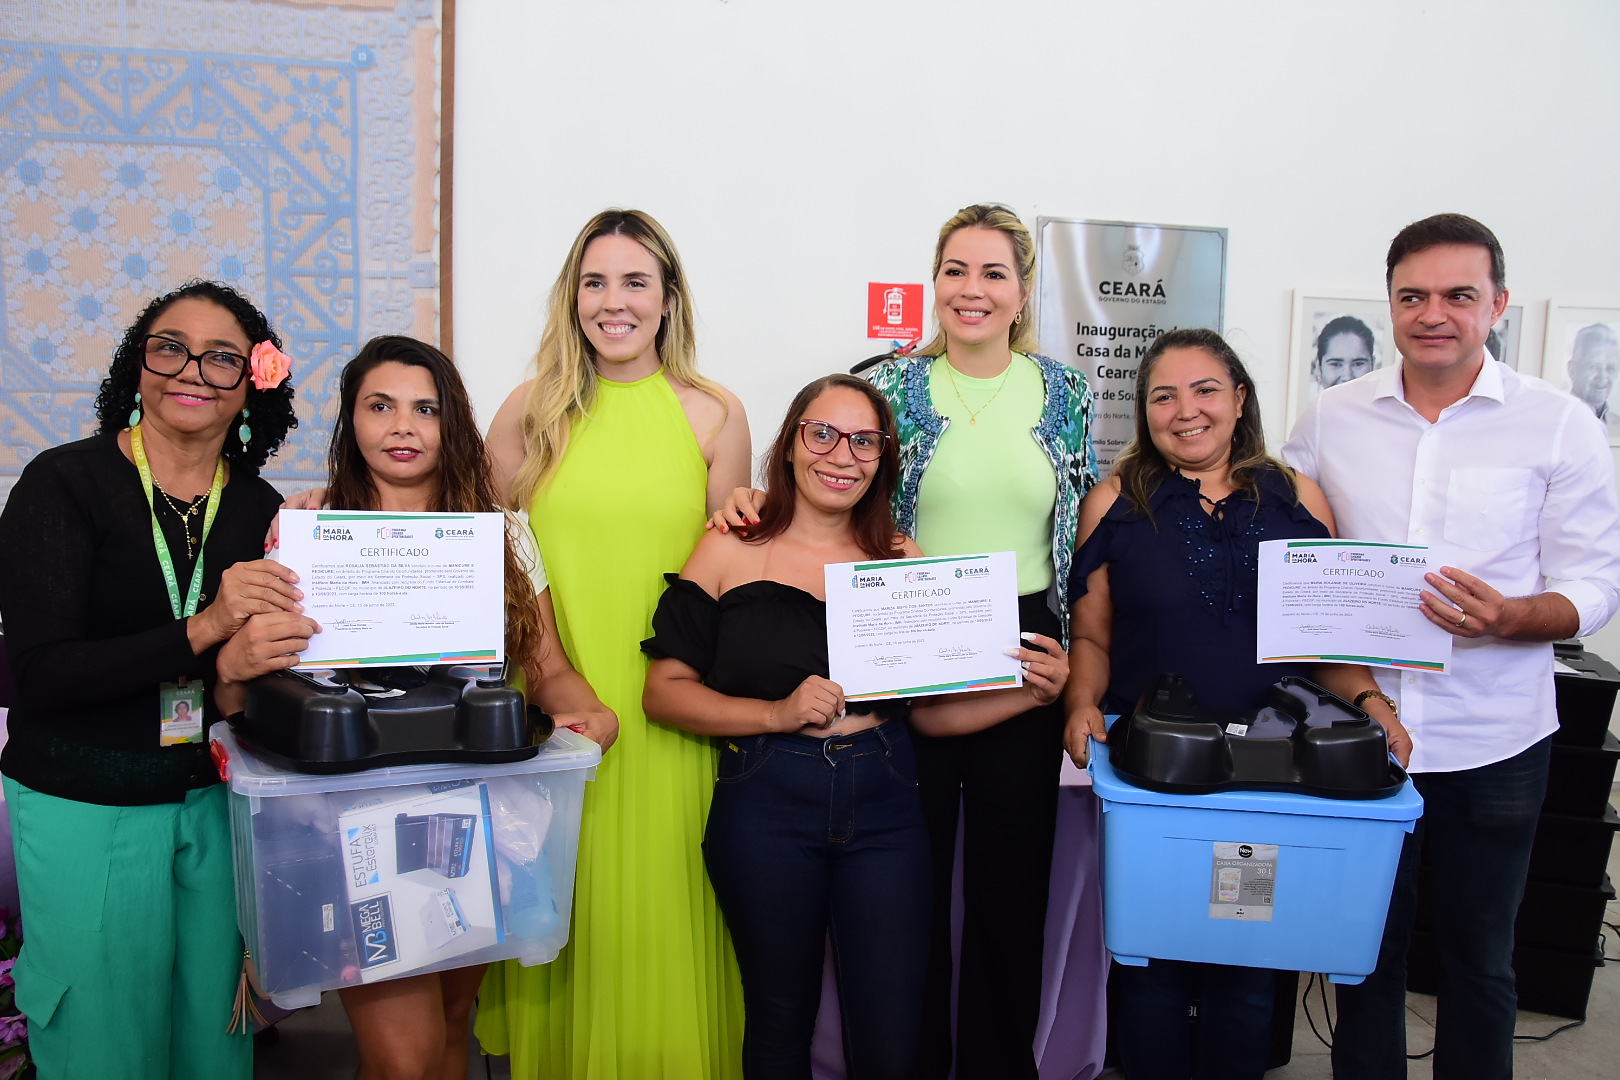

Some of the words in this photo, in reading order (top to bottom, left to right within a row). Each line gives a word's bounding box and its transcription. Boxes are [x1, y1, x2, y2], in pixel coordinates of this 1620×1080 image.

[1098, 279, 1166, 298] CEARÁ
[1098, 296, 1130, 304] GOVERNO
[1076, 322, 1165, 343] Inauguração
[1077, 343, 1110, 357] Casa
[1114, 344, 1131, 358] da
[1102, 389, 1115, 401] de
[445, 528, 474, 536] CEARÁ
[153, 527, 167, 555] CEARÁ
[360, 547, 429, 557] CERTIFICADO
[1400, 556, 1427, 565] CEARÁ
[162, 560, 177, 587] CEARÁ
[964, 566, 990, 575] CEARÁ
[1322, 568, 1385, 579] CERTIFICADO
[193, 568, 203, 594] CEARÁ
[891, 588, 951, 600] CERTIFICADO
[361, 824, 377, 872] Esterelix
[349, 837, 367, 888] ESTUFA
[1257, 868, 1266, 876] 30
[359, 903, 373, 934] MEGA
[369, 900, 383, 930] BELL
